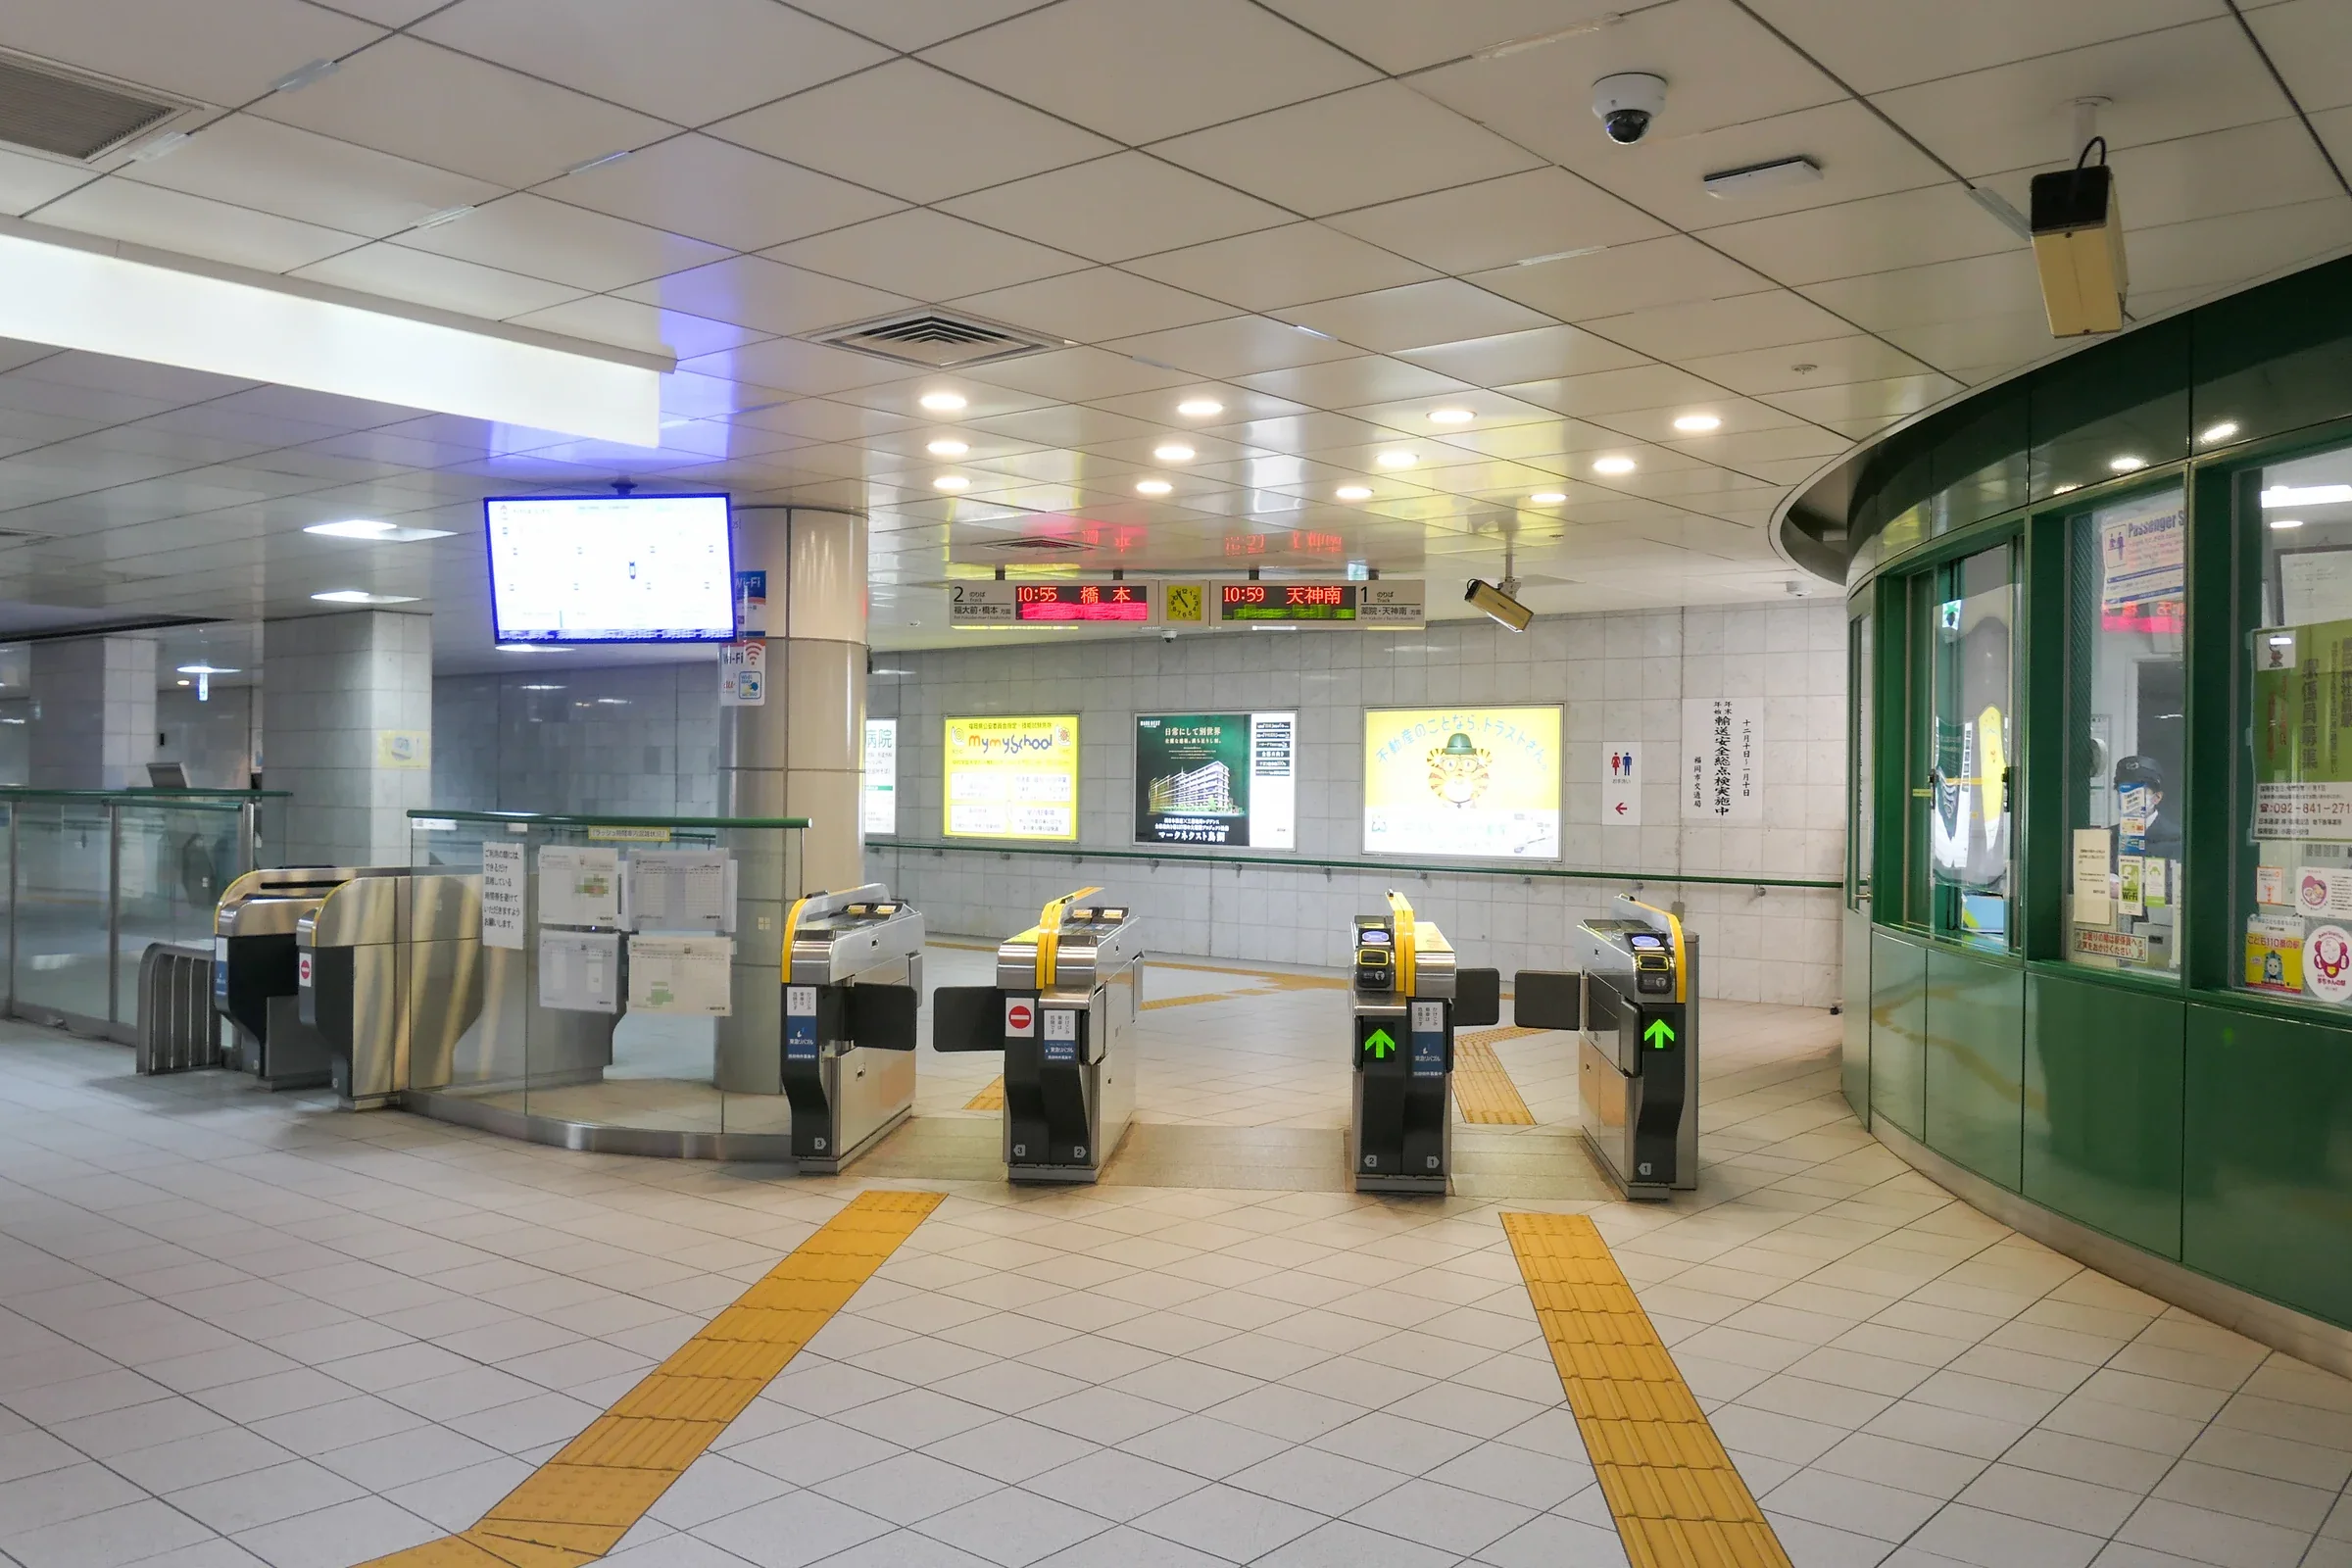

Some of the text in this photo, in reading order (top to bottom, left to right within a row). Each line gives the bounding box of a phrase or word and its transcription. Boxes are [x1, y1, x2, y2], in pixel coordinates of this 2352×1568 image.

[2128, 514, 2177, 538] Passenger
[954, 586, 964, 602] 2
[1017, 587, 1057, 602] 10:55
[1224, 587, 1264, 602] 10:59
[1286, 586, 1343, 605] 天神南
[1360, 586, 1367, 603] 1
[723, 653, 744, 664] Wi-Fi
[1714, 715, 1731, 816] 輸送安全総点検実施中
[1693, 757, 1702, 808] 福岡市交通局
